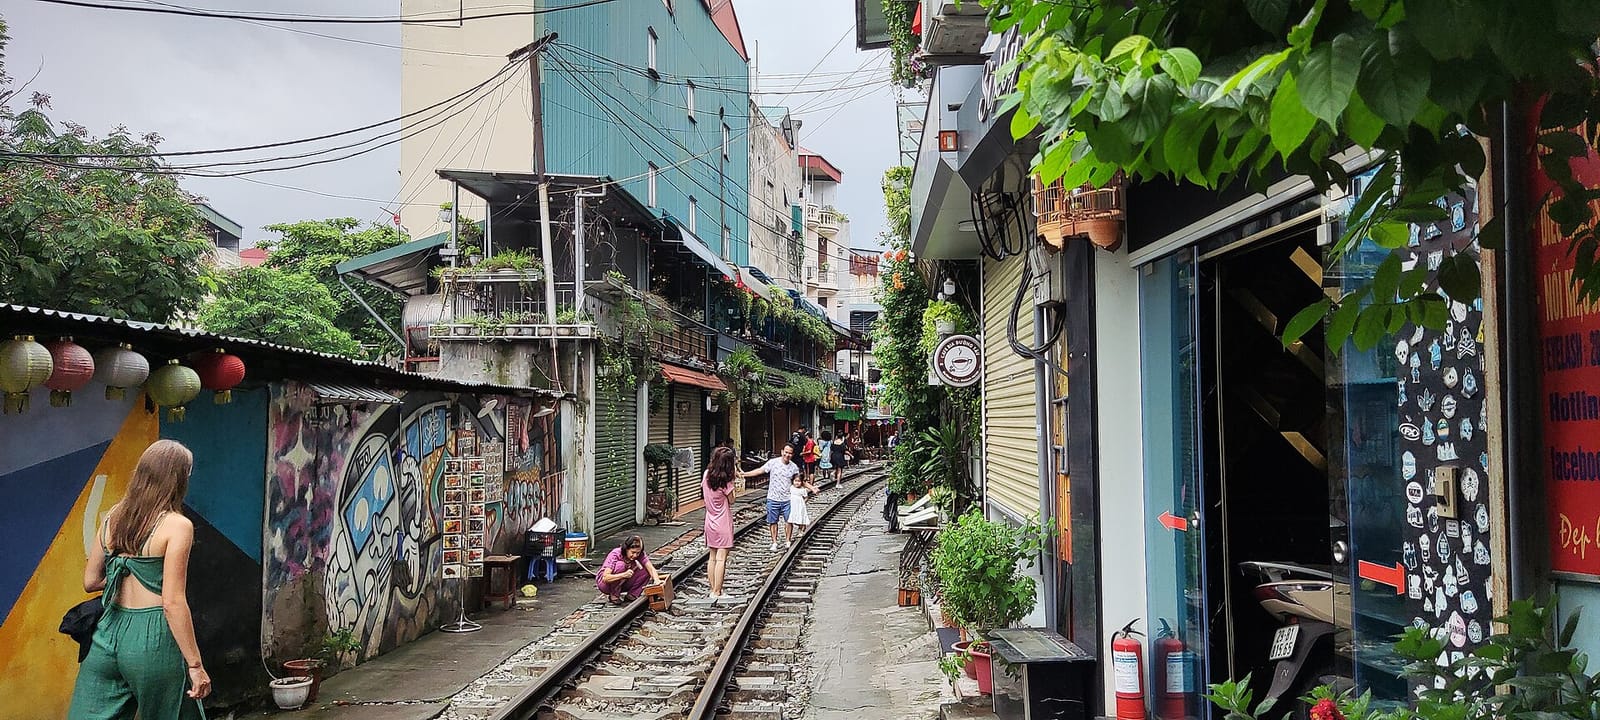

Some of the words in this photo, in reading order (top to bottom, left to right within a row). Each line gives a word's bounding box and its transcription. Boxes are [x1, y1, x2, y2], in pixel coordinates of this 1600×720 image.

[1543, 257, 1564, 321] NỐI
[1550, 391, 1600, 421] Hotlin
[1559, 512, 1591, 560] Đẹp
